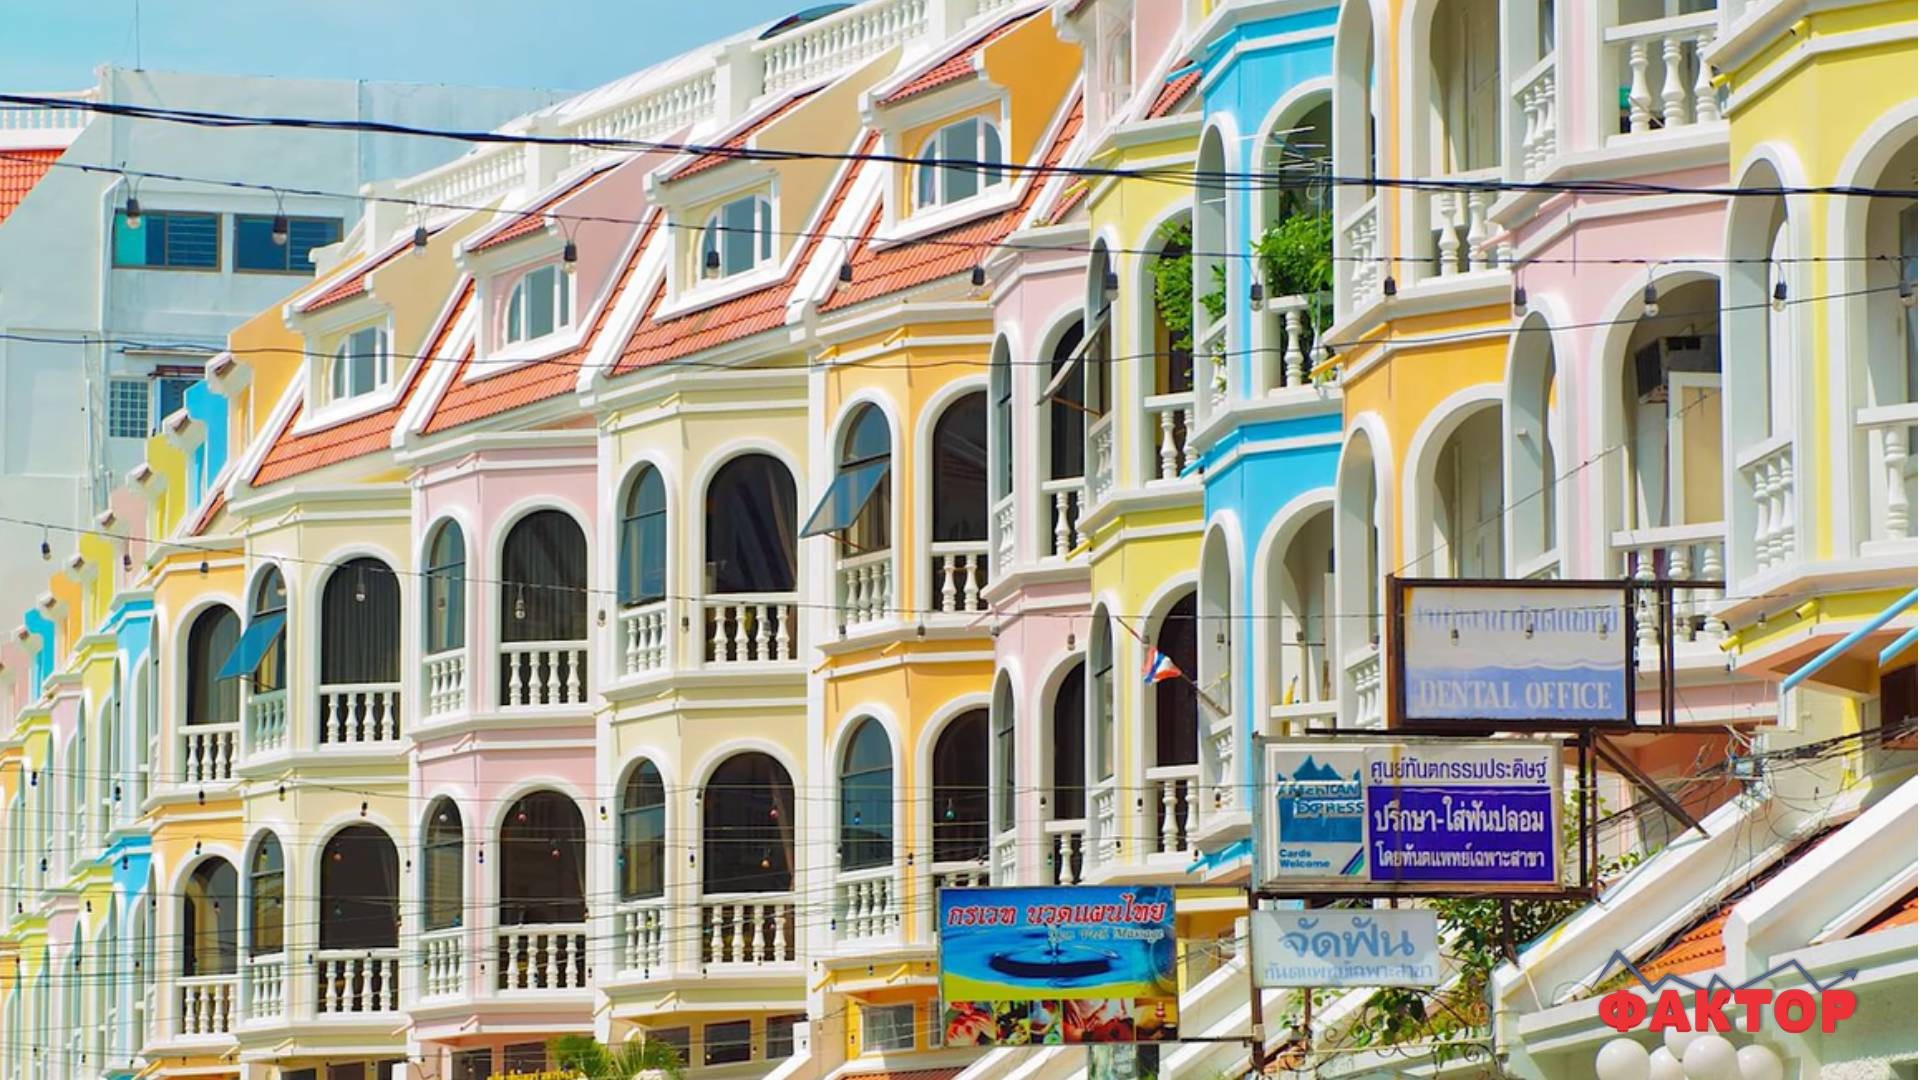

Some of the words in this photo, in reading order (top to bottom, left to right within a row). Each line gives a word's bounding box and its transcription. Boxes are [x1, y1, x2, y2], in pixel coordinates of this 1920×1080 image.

[1418, 679, 1518, 710] DENTAL
[1524, 679, 1613, 710] OFFICE
[1371, 756, 1547, 784] ศูนย์ทันตกรรมประดิษฐ์
[1374, 795, 1545, 832] ปรึกษา-ใส่ฟันปลอม
[1279, 848, 1312, 858] Cards
[1279, 858, 1331, 868] Welcome
[1375, 841, 1545, 867] โดยทันตแพทย์เฉพาะสาขา
[1026, 892, 1167, 924] นวดแผนไทย
[1279, 915, 1416, 958] จัดฟัน
